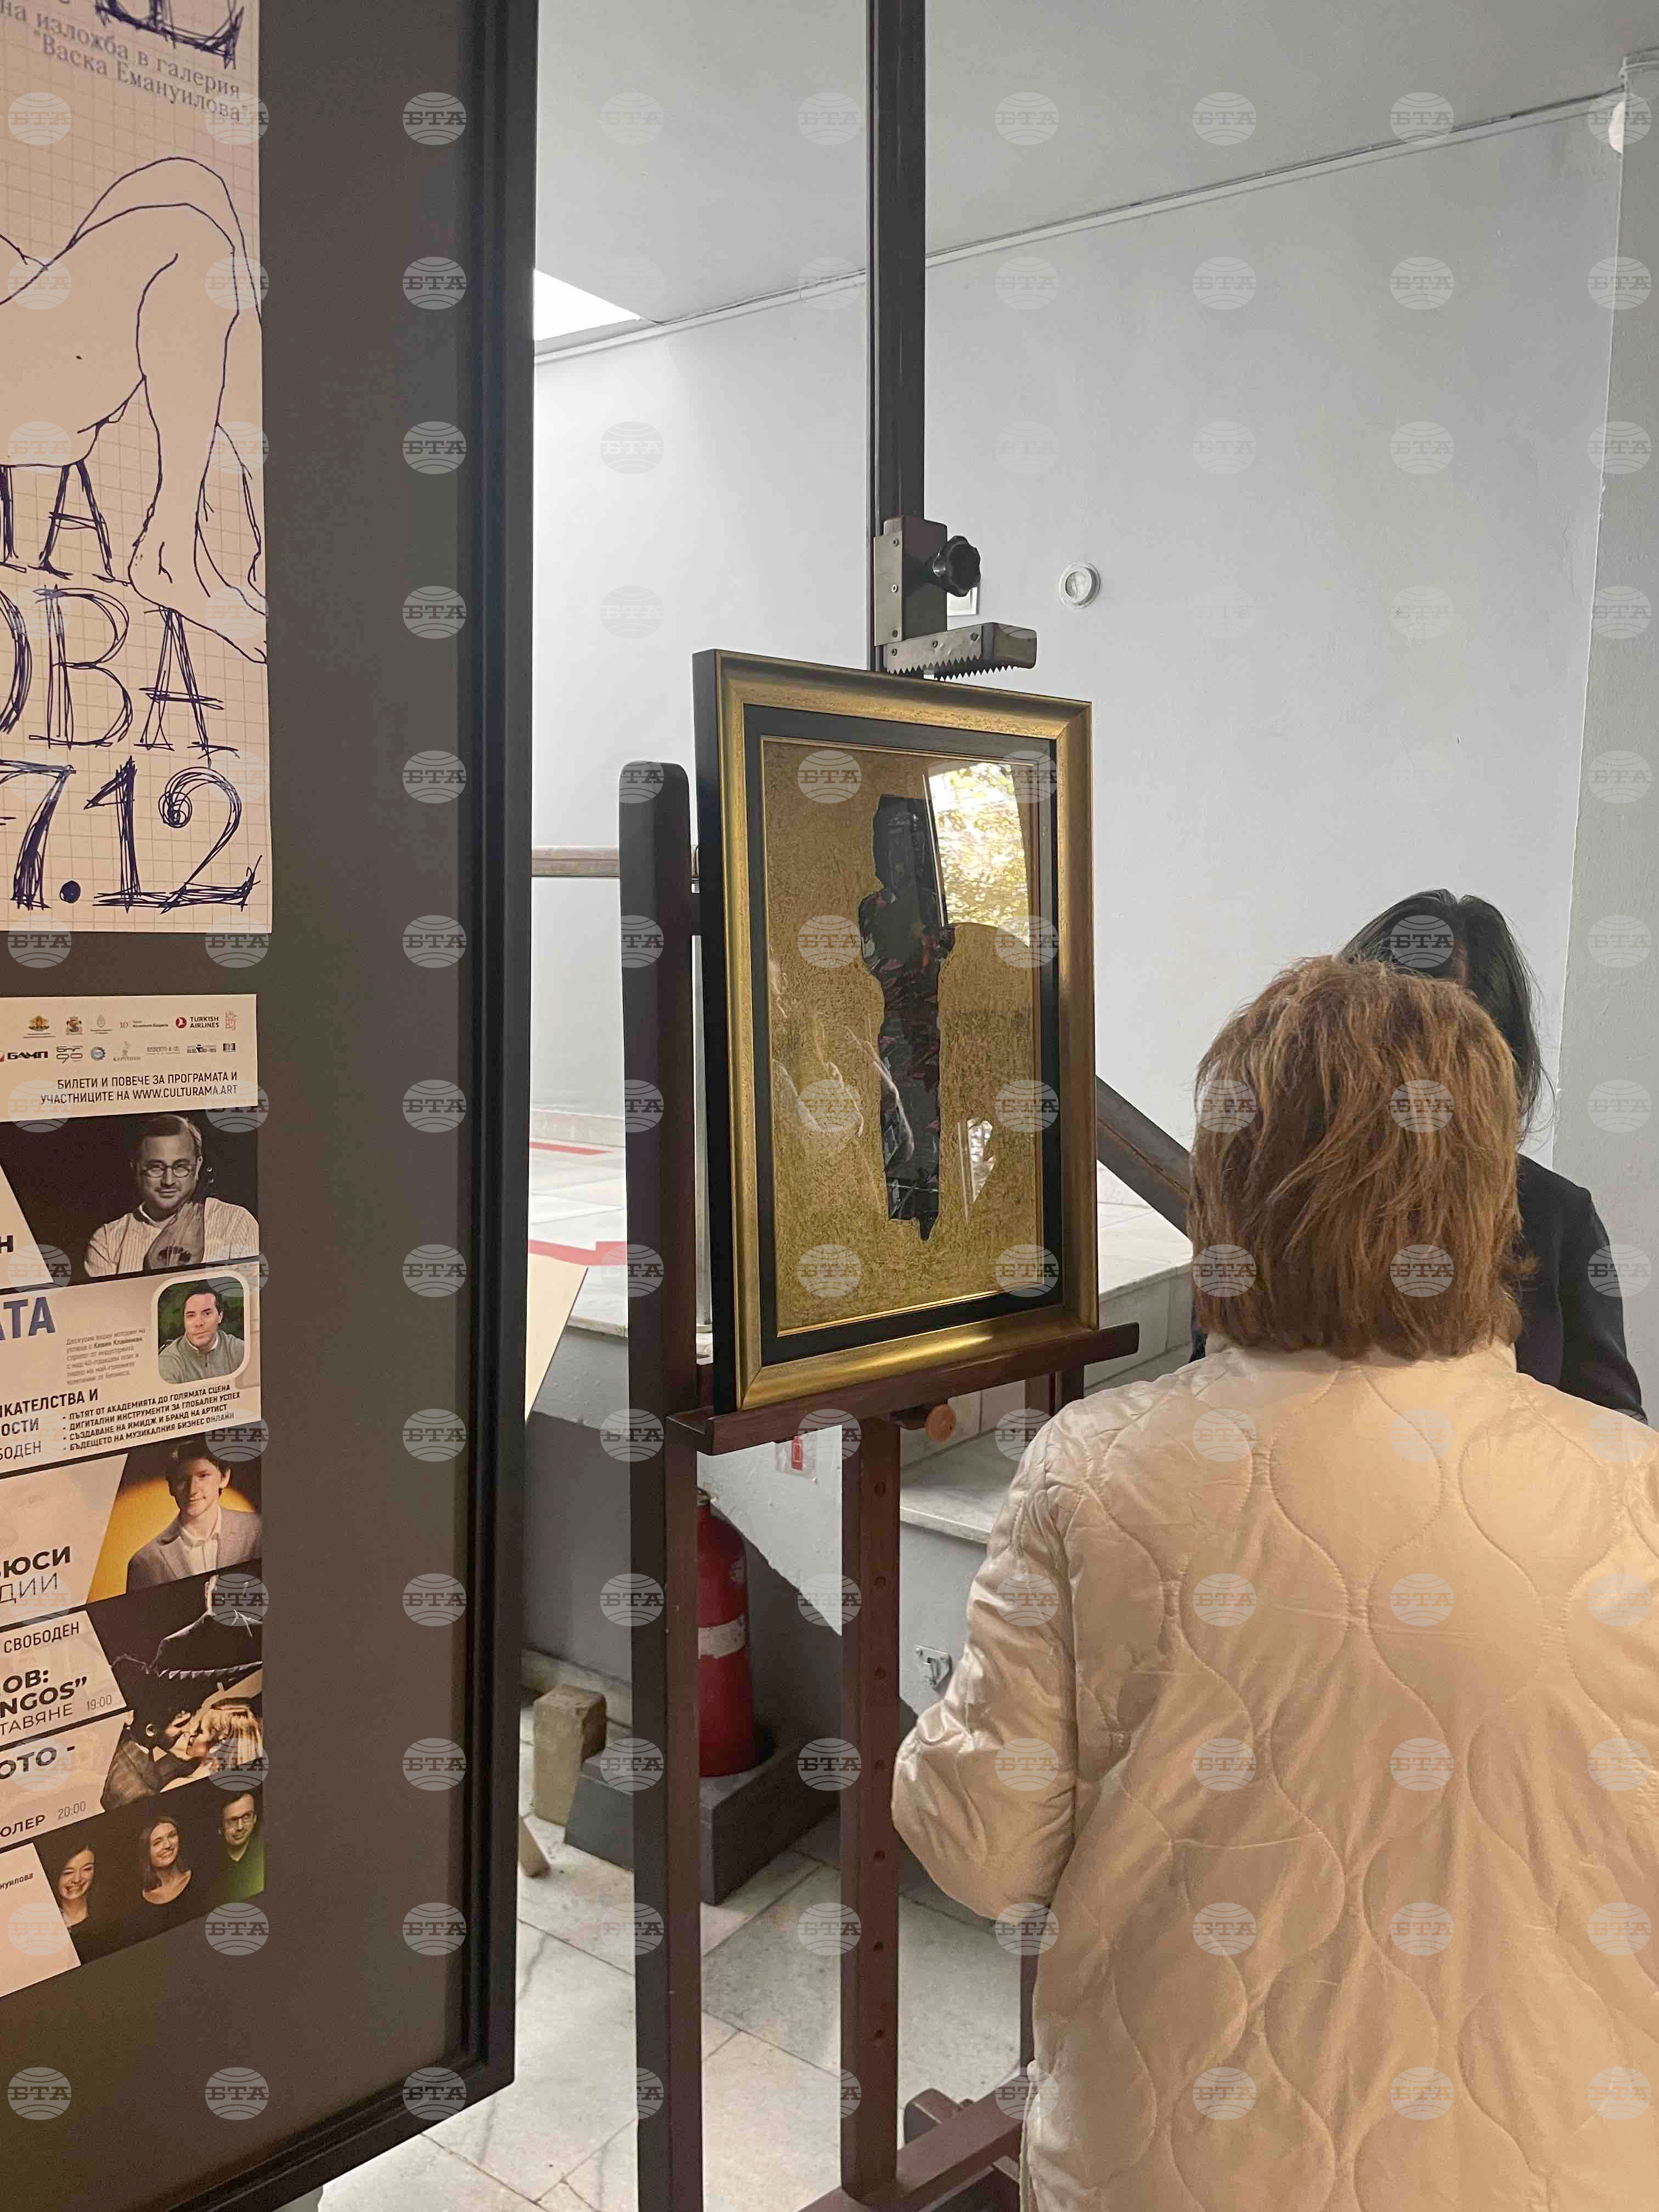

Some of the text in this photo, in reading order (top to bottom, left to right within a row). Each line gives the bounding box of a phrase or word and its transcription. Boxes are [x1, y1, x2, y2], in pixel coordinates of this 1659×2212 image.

[36, 13, 128, 60] изложба
[138, 51, 149, 66] в
[157, 58, 240, 100] галерия
[41, 1085, 237, 1105] УЧАСТНИЦИТЕ НА WWW.CULTURAMA.ART
[58, 1071, 237, 1090] БИЛЕТИ И ПОВЕЧЕ ЗА ПРОГРАМАТА И
[0, 1296, 55, 1340] ТА
[70, 1409, 94, 1420] ПЪТЯТ
[107, 1398, 156, 1413] АКАДЕМИЯТА
[158, 1396, 168, 1404] ДО
[170, 1389, 207, 1401] ГОЛЯМАТА
[208, 1384, 230, 1394] СЦЕНА
[70, 1416, 115, 1431] ДИГИТАЛНИ
[117, 1405, 170, 1421] ИНСТРУМЕНТИ
[182, 1396, 218, 1409] ГЛОБАЛЕН
[219, 1392, 240, 1401] УСПЕХ
[89, 1388, 98, 1401] И
[1, 1418, 39, 1436] ОСТИ
[70, 1426, 115, 1440] СЪЗДАВАНЕ
[128, 1417, 157, 1429] ИМИДЖ
[166, 1412, 189, 1421] БРАНД
[202, 1404, 227, 1414] АРТИСТ
[70, 1436, 112, 1451] БЪДЕЩЕТО
[126, 1424, 175, 1440] МУЗИКАЛНИЯ
[178, 1418, 205, 1430] БИЗНЕС
[206, 1412, 234, 1424] ОНЛАЙН
[4, 1621, 80, 1654] СВОБОДЕН
[0, 1695, 112, 1735] ТАВЯНЕ 19:00
[0, 1801, 86, 1837] ОЛЕР 20:00
